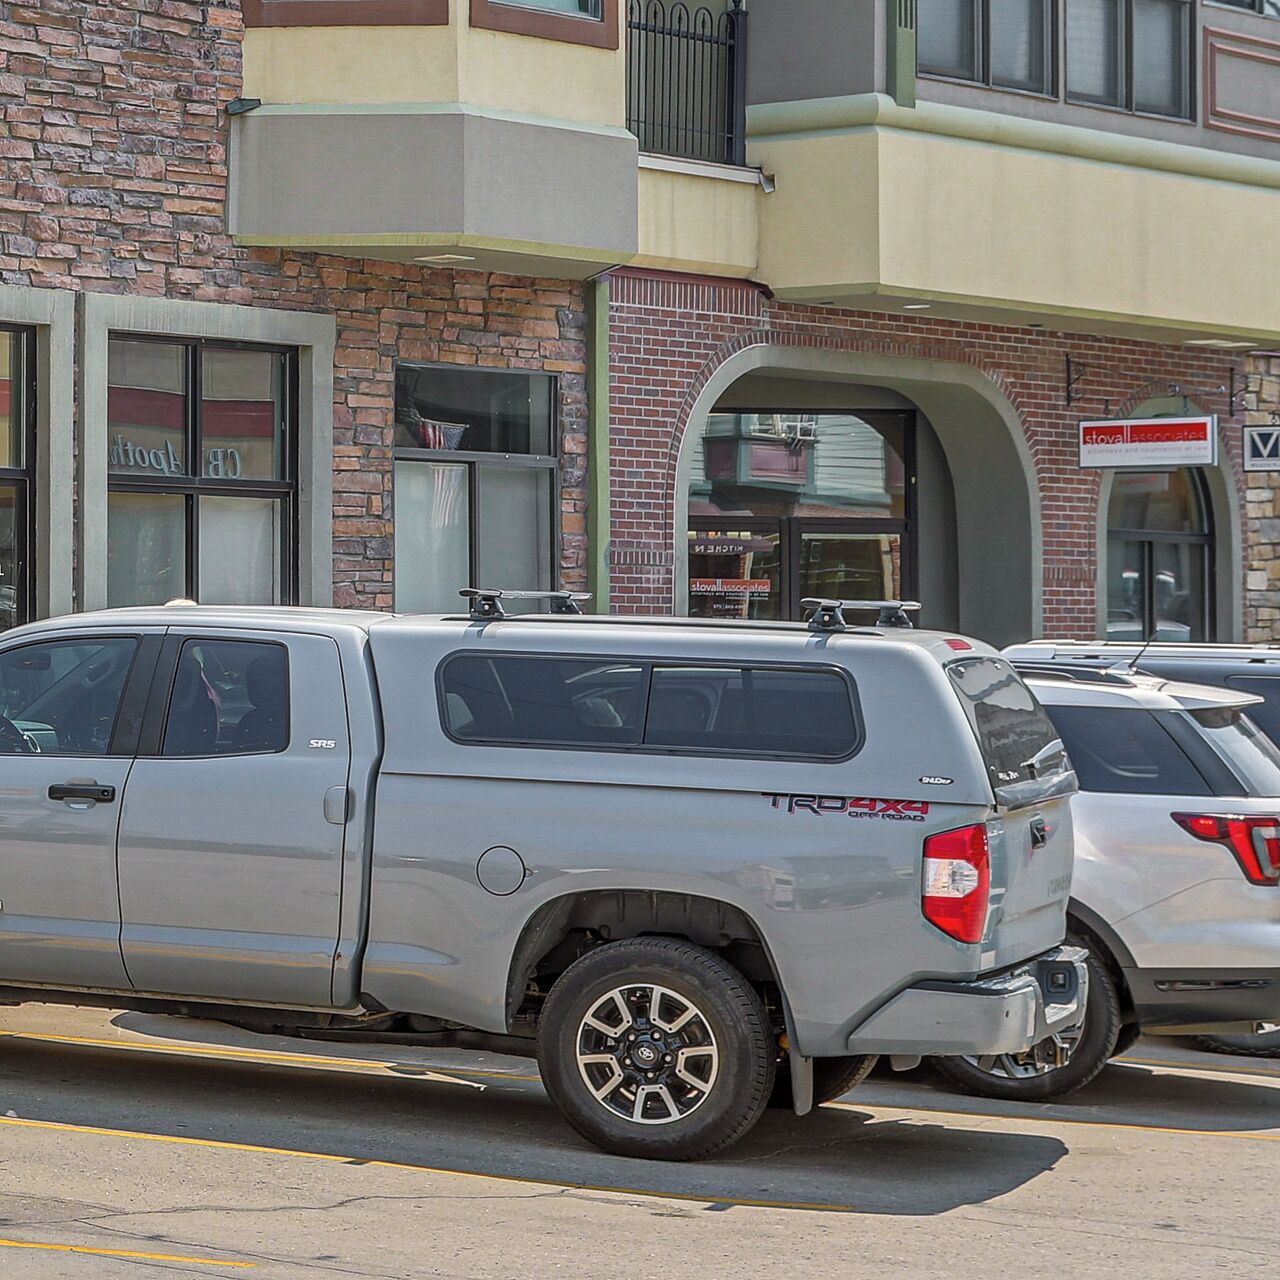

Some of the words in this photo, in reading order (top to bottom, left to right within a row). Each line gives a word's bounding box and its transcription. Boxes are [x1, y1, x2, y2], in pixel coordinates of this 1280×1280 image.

[1085, 425, 1130, 446] stovall
[690, 579, 722, 592] stovall
[308, 739, 337, 749] SR5
[760, 792, 849, 817] TRD
[848, 810, 880, 819] OFF
[881, 812, 926, 823] ROAD
